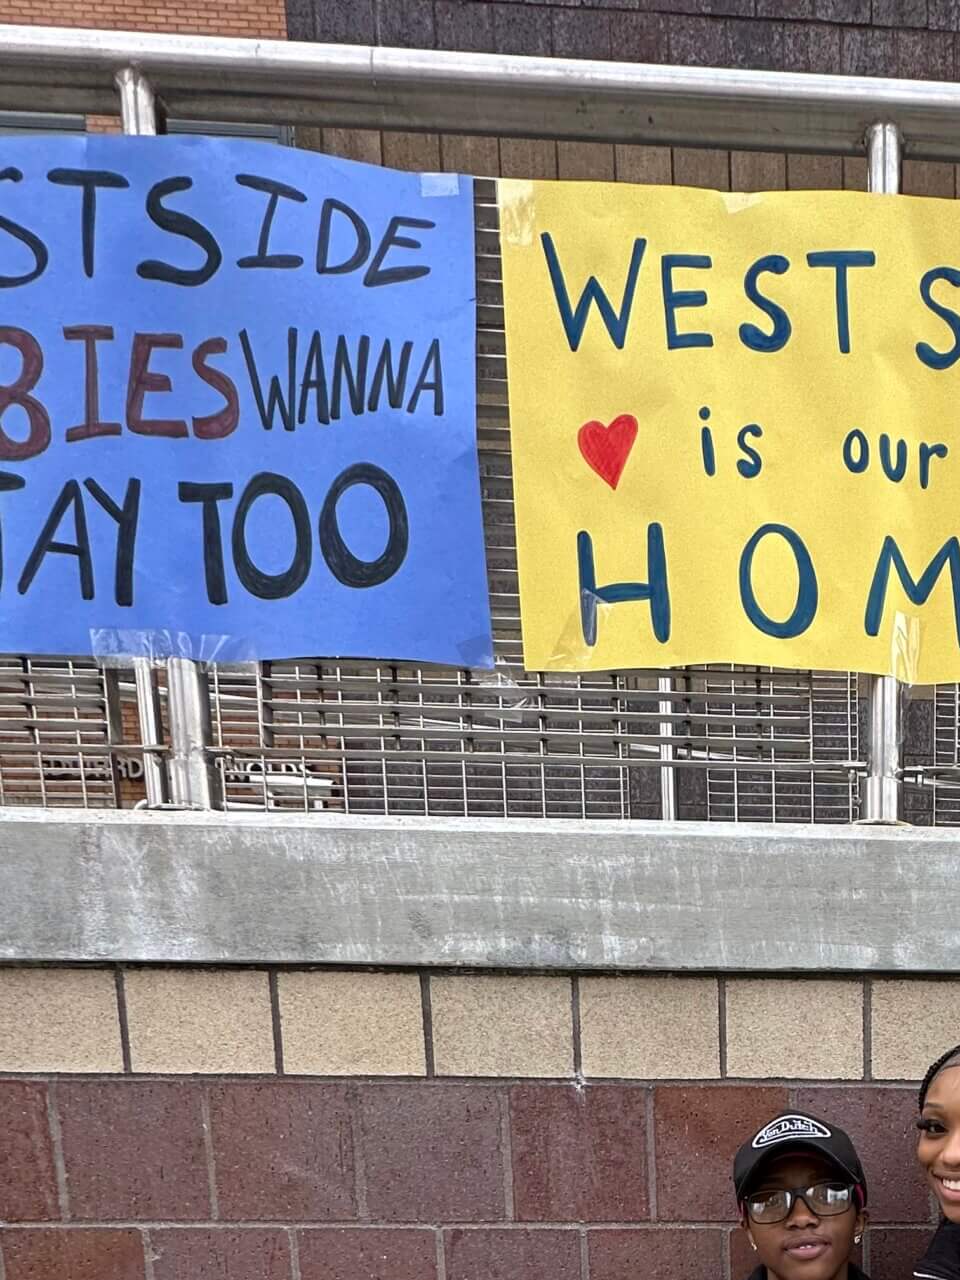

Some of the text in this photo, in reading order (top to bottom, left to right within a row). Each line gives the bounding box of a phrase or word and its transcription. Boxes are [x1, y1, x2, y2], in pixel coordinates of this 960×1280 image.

[540, 231, 876, 354] WEST
[239, 328, 444, 431] WANNA
[699, 406, 948, 489] is our
[178, 462, 409, 606] TOO
